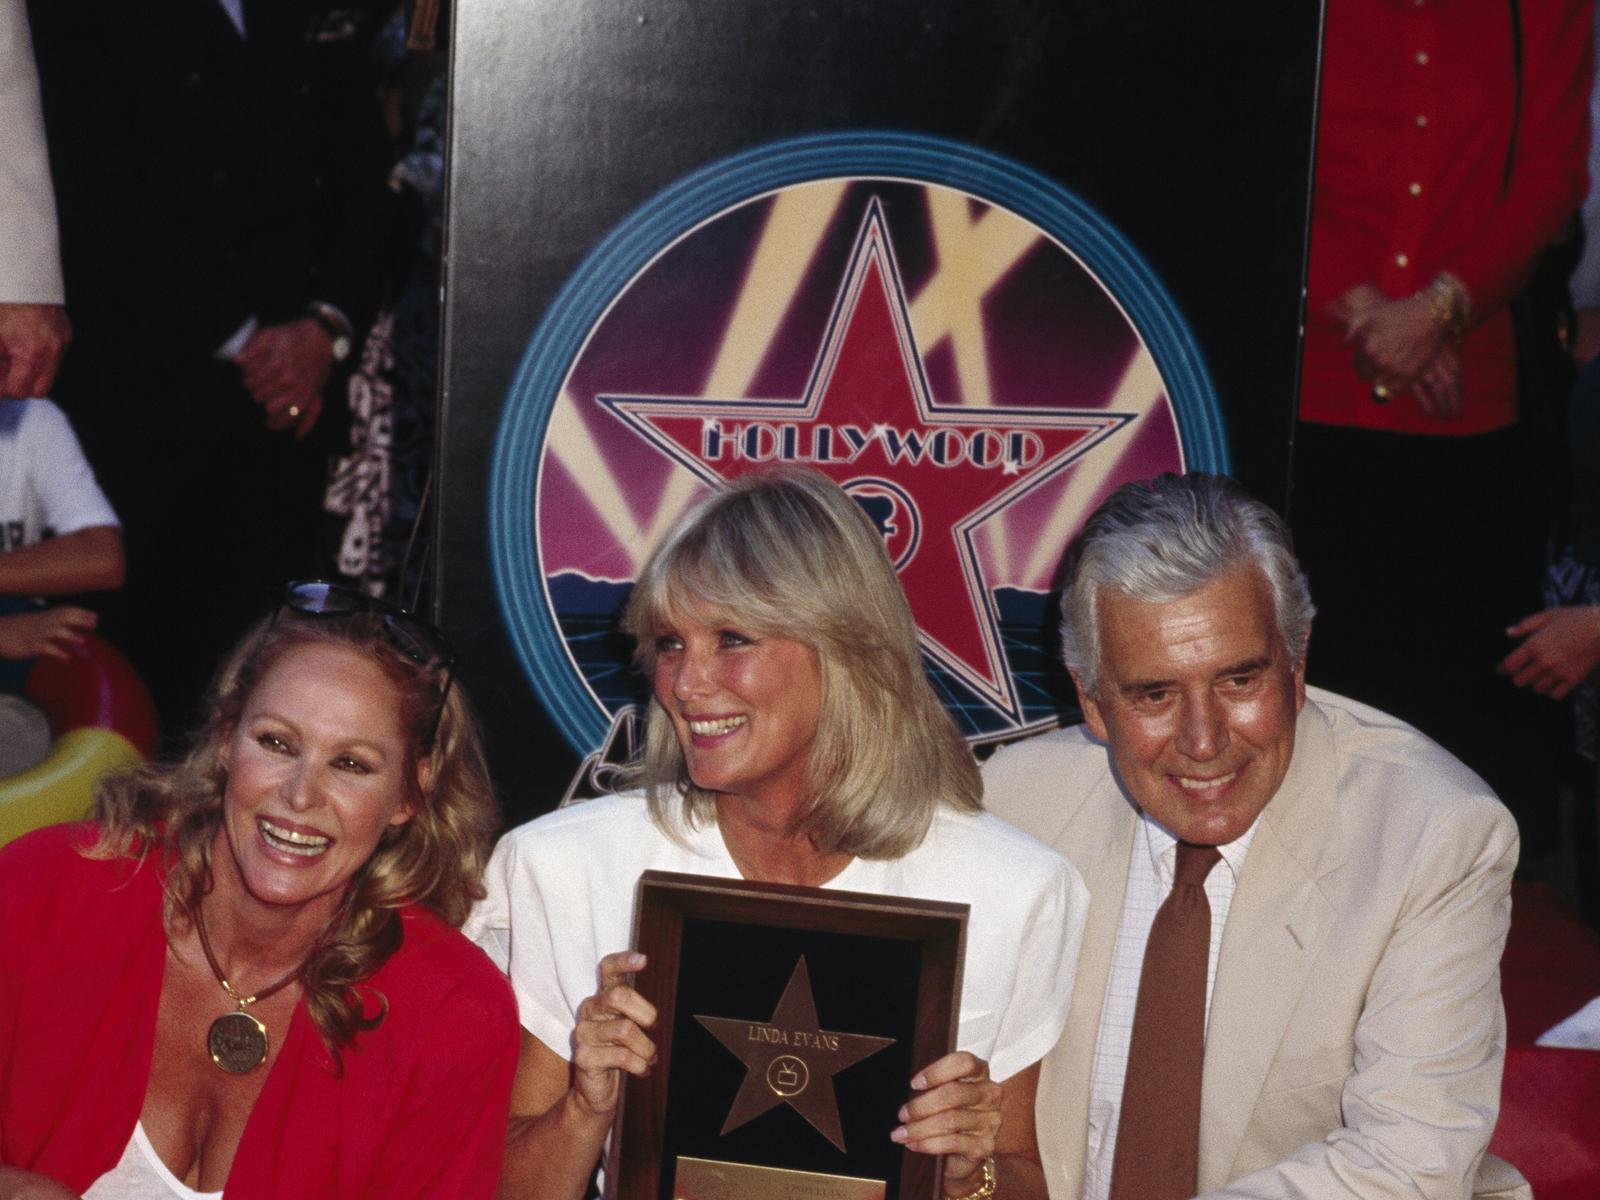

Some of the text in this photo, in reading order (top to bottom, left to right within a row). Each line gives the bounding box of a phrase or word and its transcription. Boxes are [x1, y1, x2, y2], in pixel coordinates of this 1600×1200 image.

[703, 420, 1043, 469] HOLLYWOOD
[748, 1025, 839, 1051] LINDA EVANS
